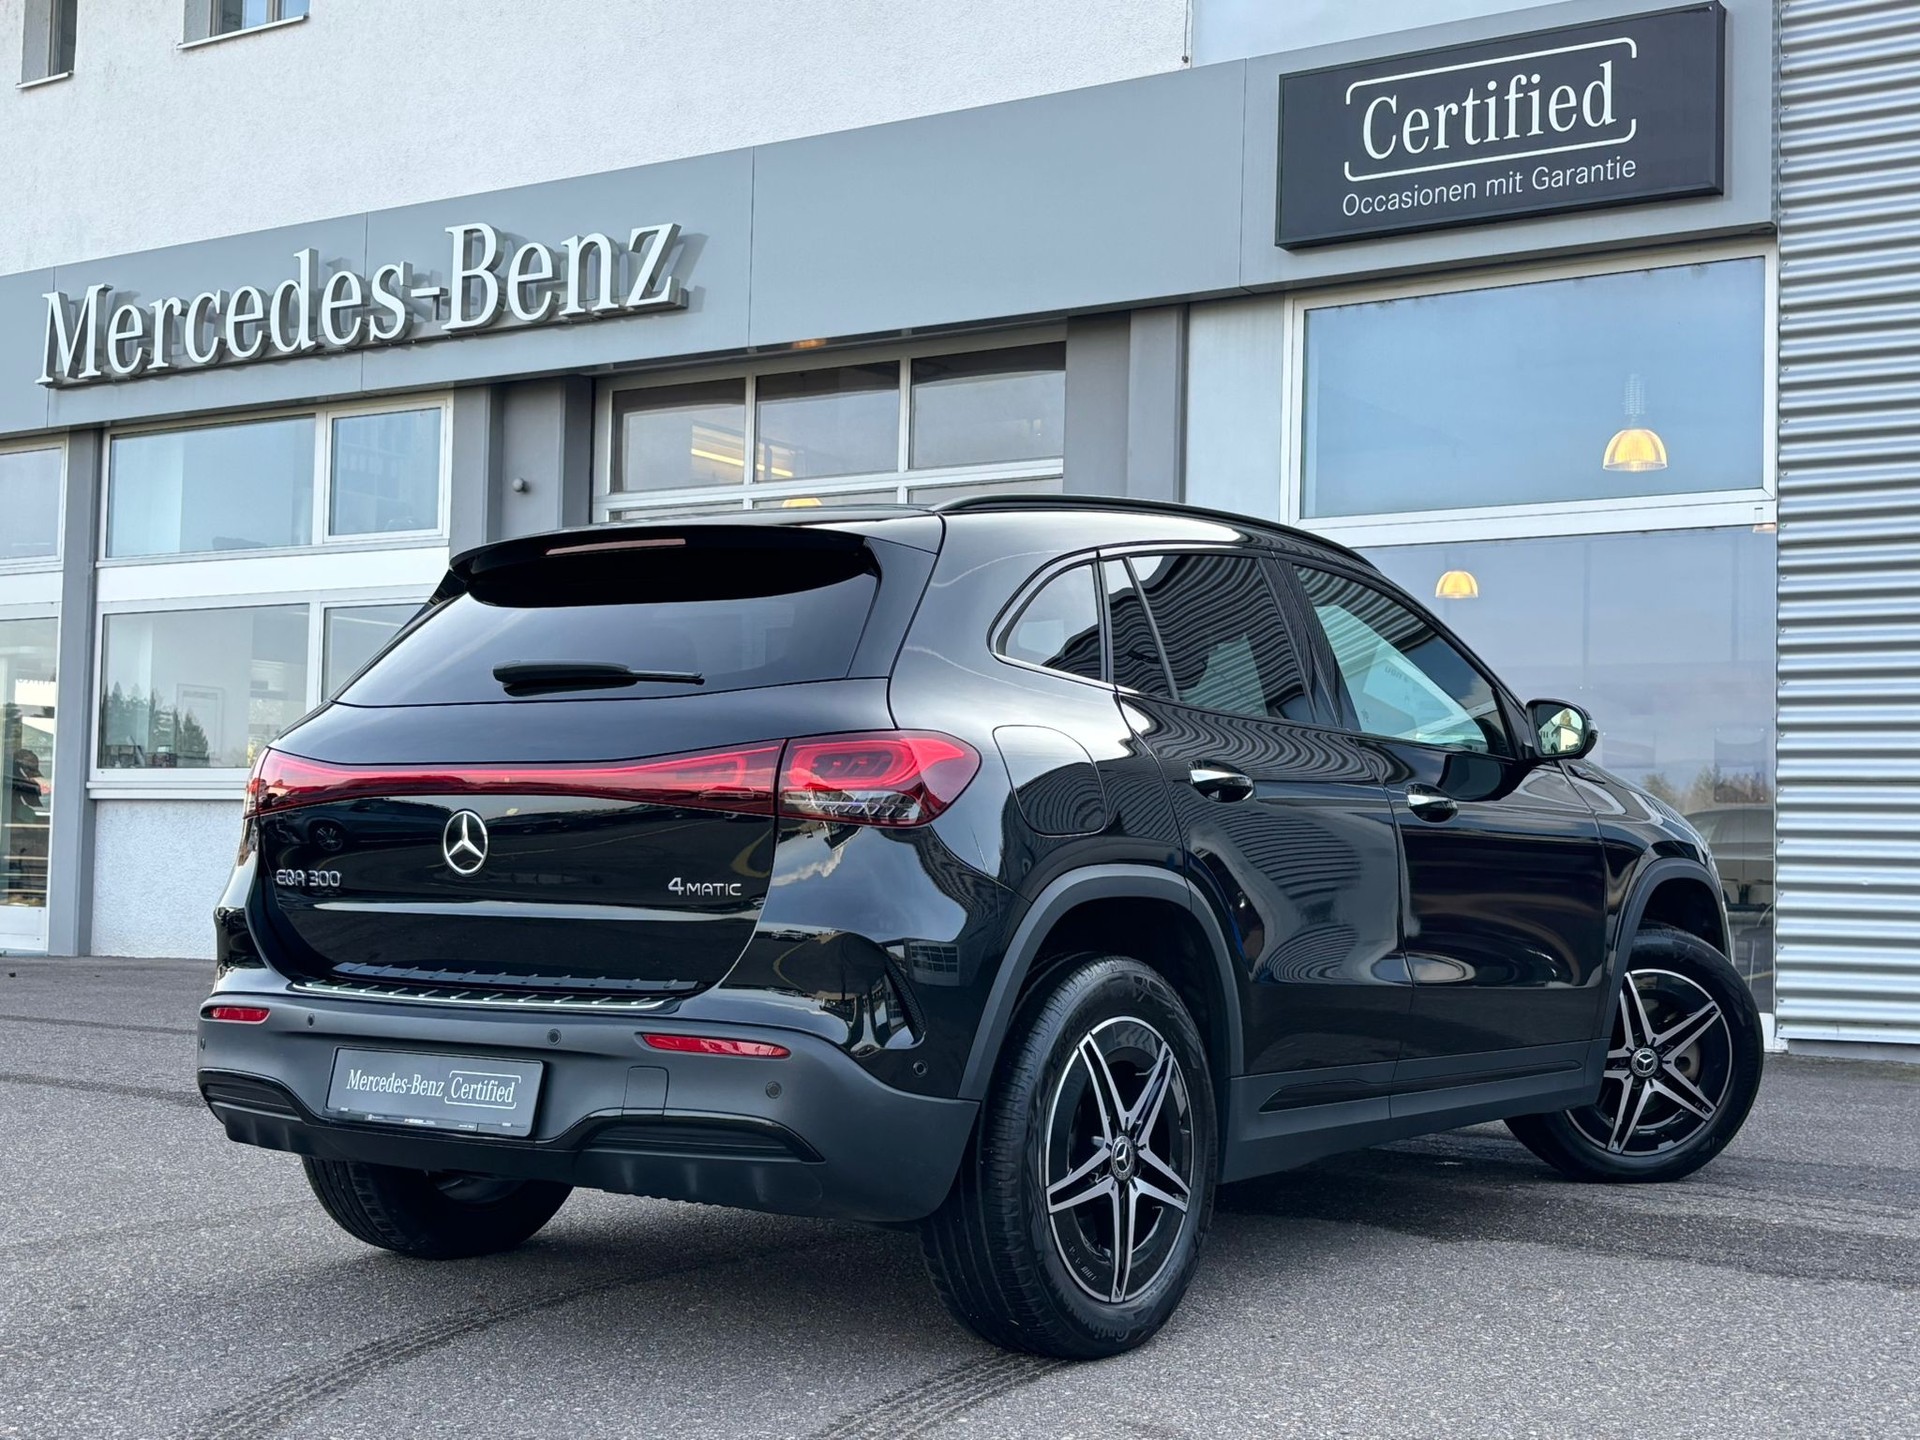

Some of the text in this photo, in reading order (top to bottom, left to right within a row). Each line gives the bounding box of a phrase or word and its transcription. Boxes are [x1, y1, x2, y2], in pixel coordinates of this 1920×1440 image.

[1362, 60, 1617, 160] Certified
[1342, 156, 1637, 217] Occasionen mit Garantie
[34, 222, 678, 384] Mercedes-Benz
[276, 868, 341, 887] EQA 300
[667, 876, 742, 896] 4MATIC
[345, 1068, 516, 1103] Mercedes-Benz Certified
